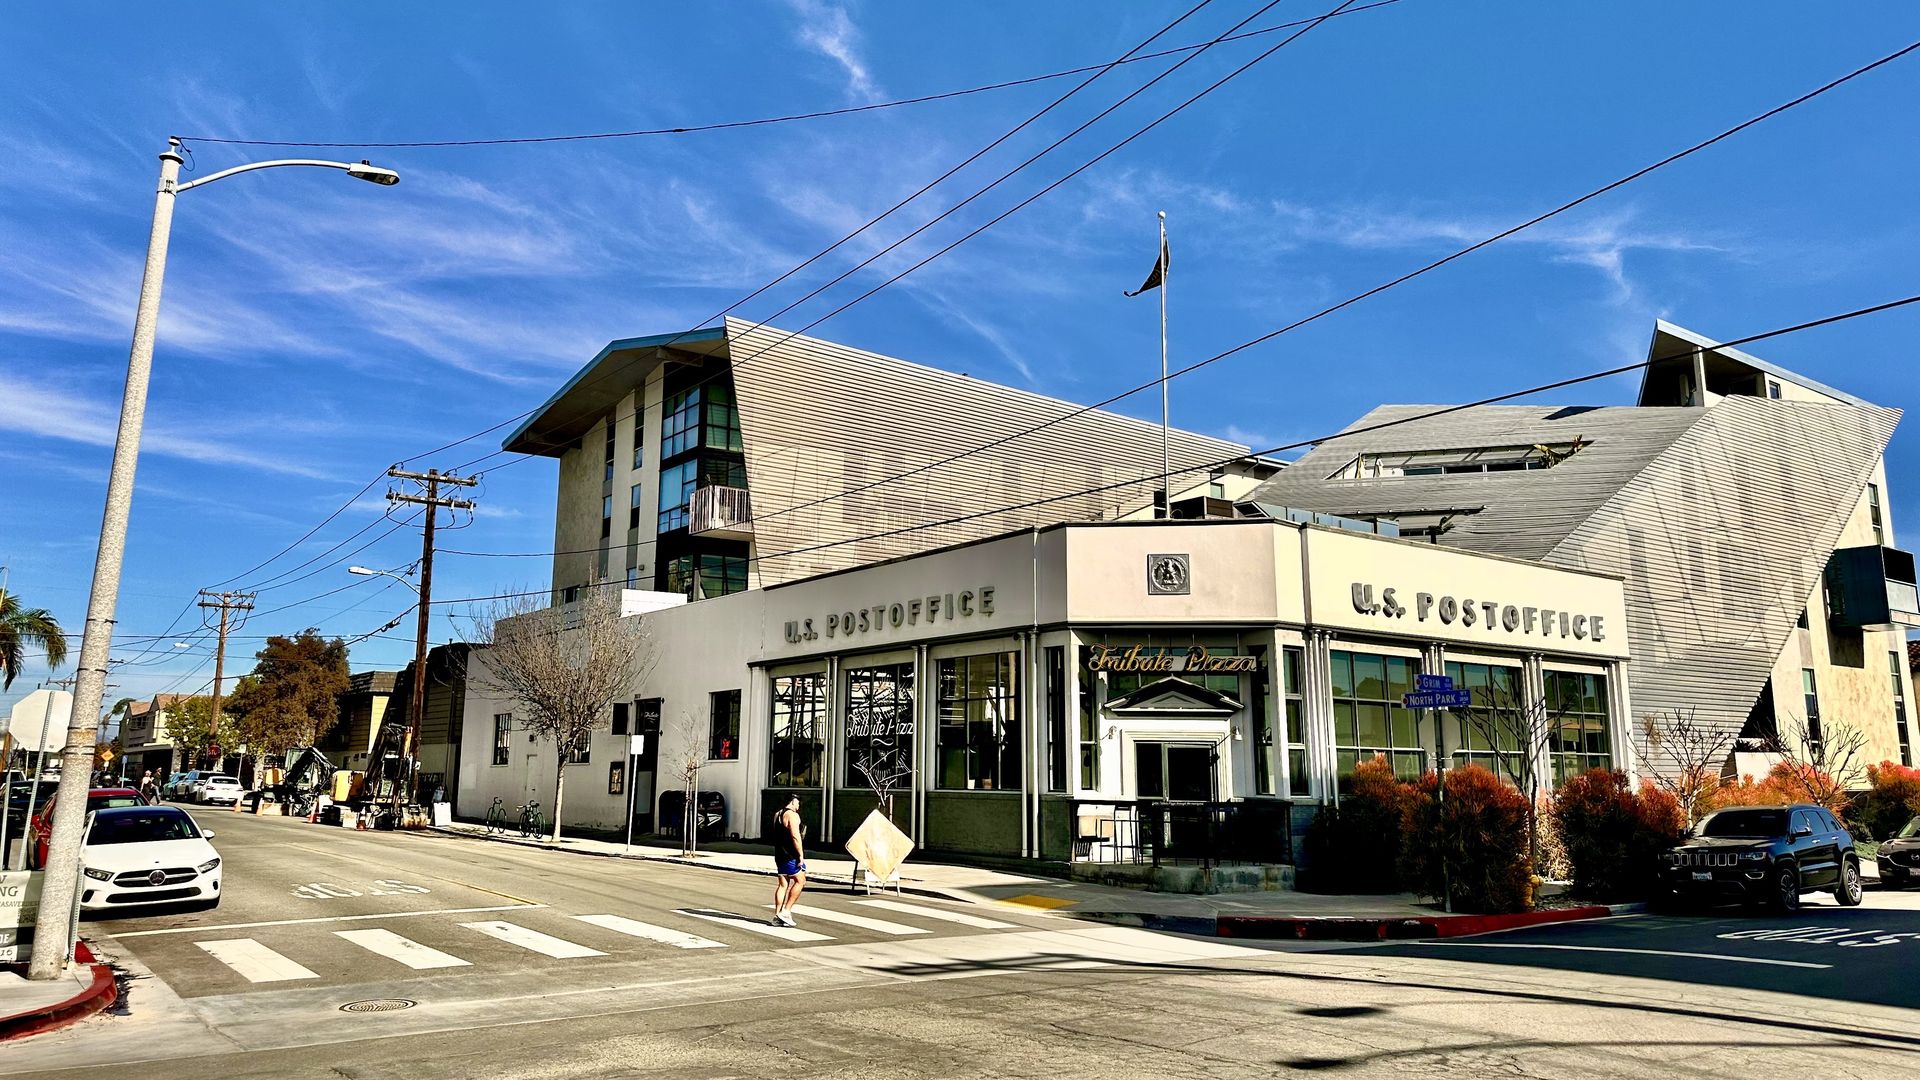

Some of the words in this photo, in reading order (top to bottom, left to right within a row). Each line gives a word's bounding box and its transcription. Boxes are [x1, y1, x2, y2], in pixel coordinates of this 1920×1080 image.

[1351, 583, 1406, 619] U.S.
[784, 618, 818, 643] U.S.
[1088, 643, 1174, 672] Tribute
[1187, 645, 1257, 672] Pizza
[1409, 695, 1433, 706] NORTH
[1435, 693, 1456, 705] PARK
